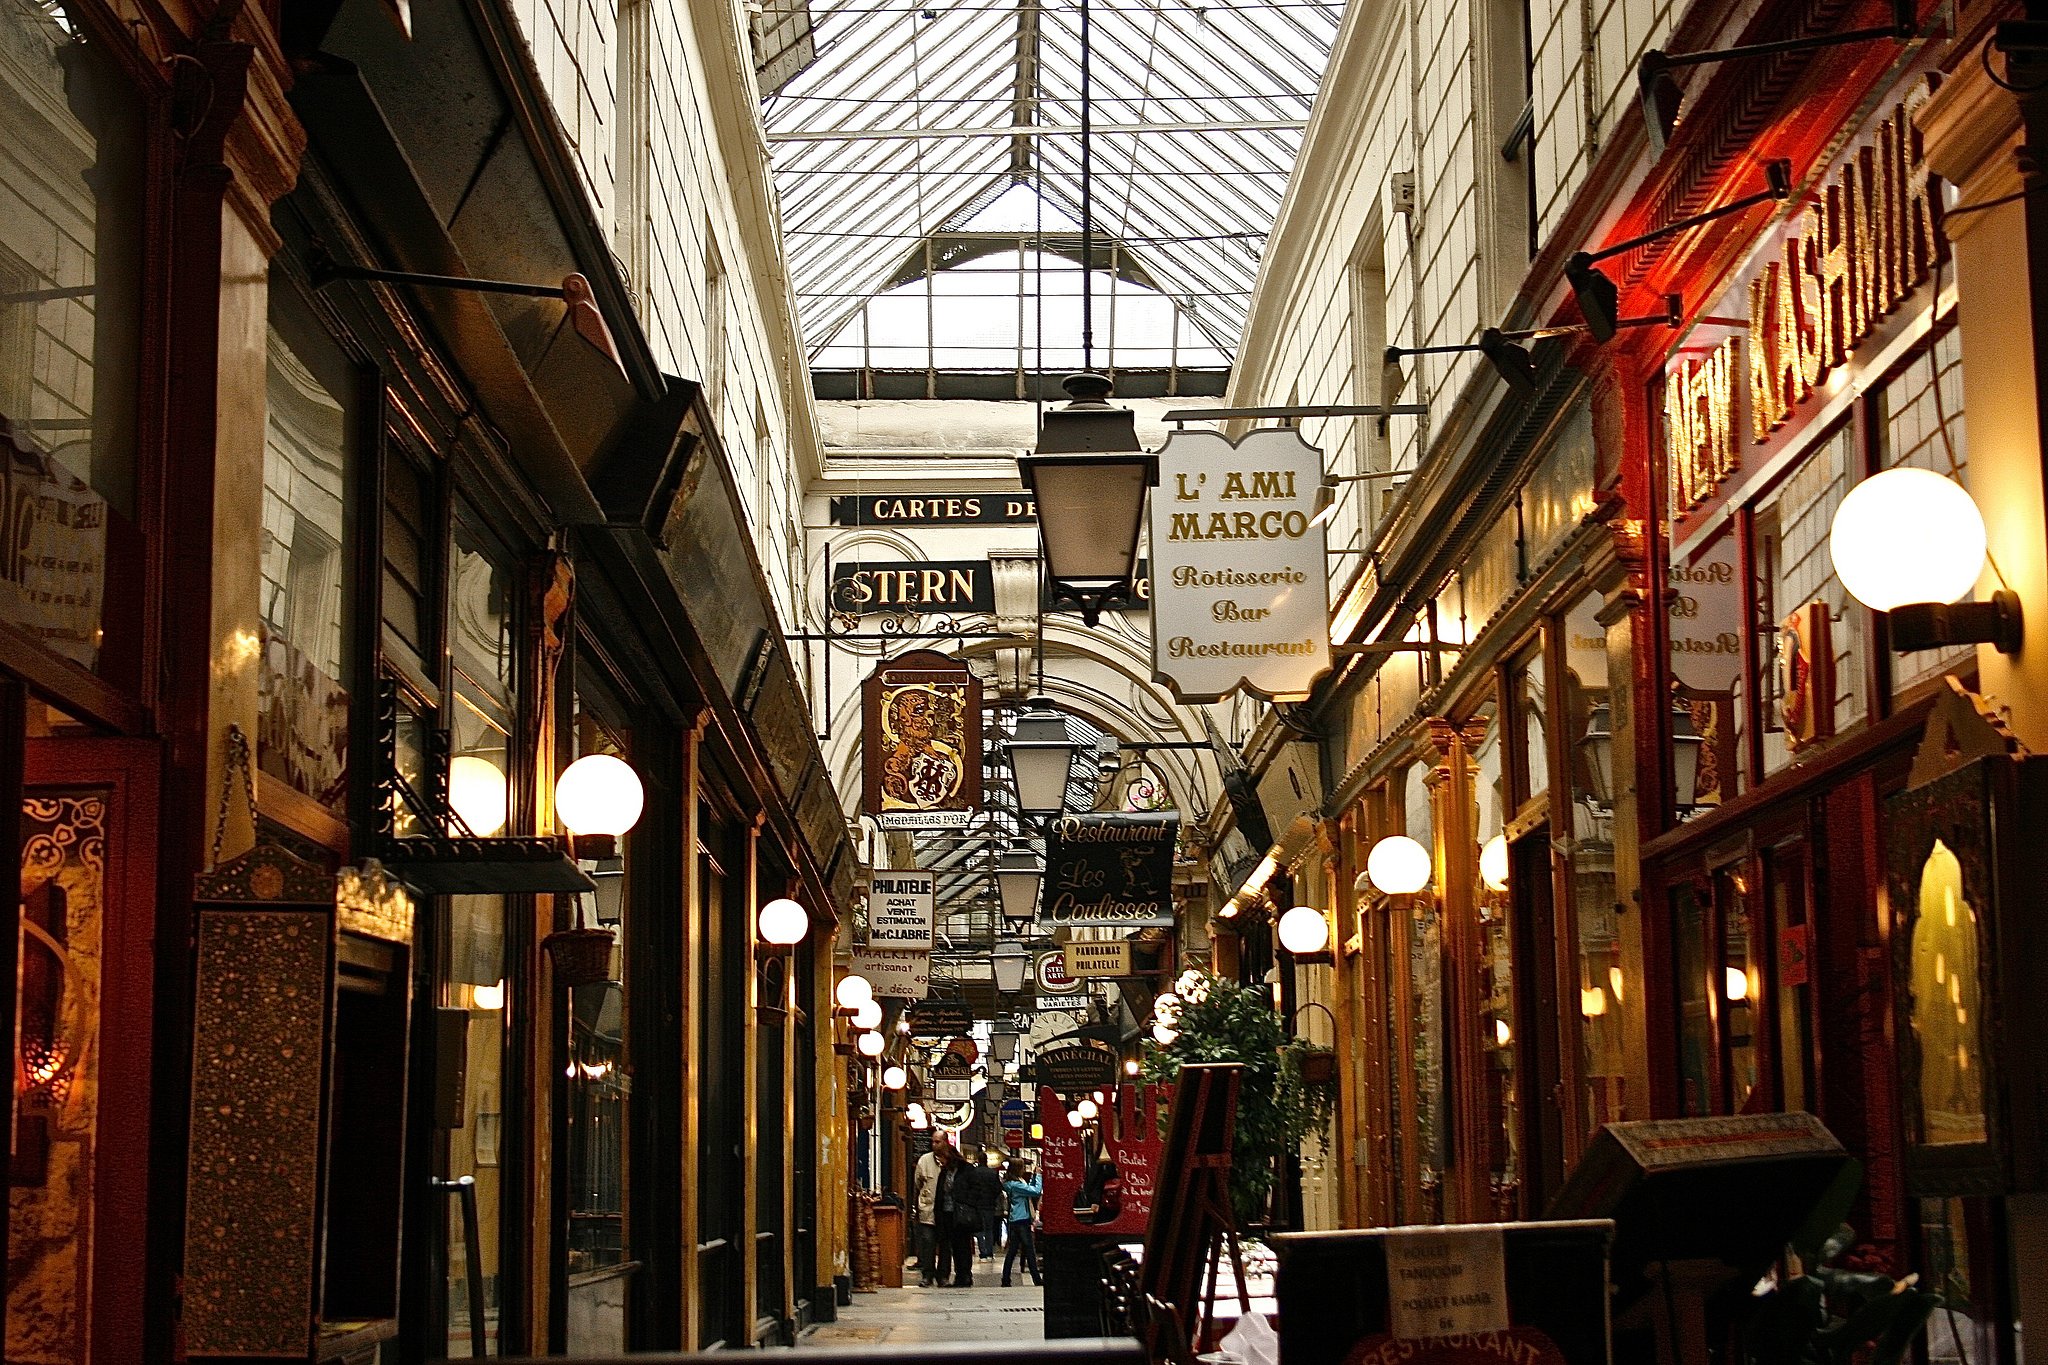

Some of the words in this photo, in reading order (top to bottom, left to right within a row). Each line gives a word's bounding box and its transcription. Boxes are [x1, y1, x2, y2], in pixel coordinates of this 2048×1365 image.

[1177, 472, 1208, 500] L'
[1220, 470, 1297, 500] AMI
[873, 498, 982, 520] CARTES
[1168, 510, 1309, 541] MARCO
[852, 568, 976, 606] STERN
[1171, 565, 1307, 588] Rôtisserie
[1212, 600, 1271, 624] Bar
[1169, 635, 1317, 660] Restaurant
[1052, 815, 1168, 844] Restaurant
[1057, 858, 1106, 890] Les
[886, 898, 917, 906] ACHAT
[886, 908, 917, 916] VENTE
[1052, 892, 1159, 924] Coulisses
[876, 917, 926, 925] ESTIMATION
[1075, 946, 1121, 956] PANORAMAS
[865, 962, 914, 972] artisanat
[1076, 960, 1120, 970] PHILATELIE
[913, 975, 927, 985] 49
[1118, 1149, 1148, 1166] Poulet
